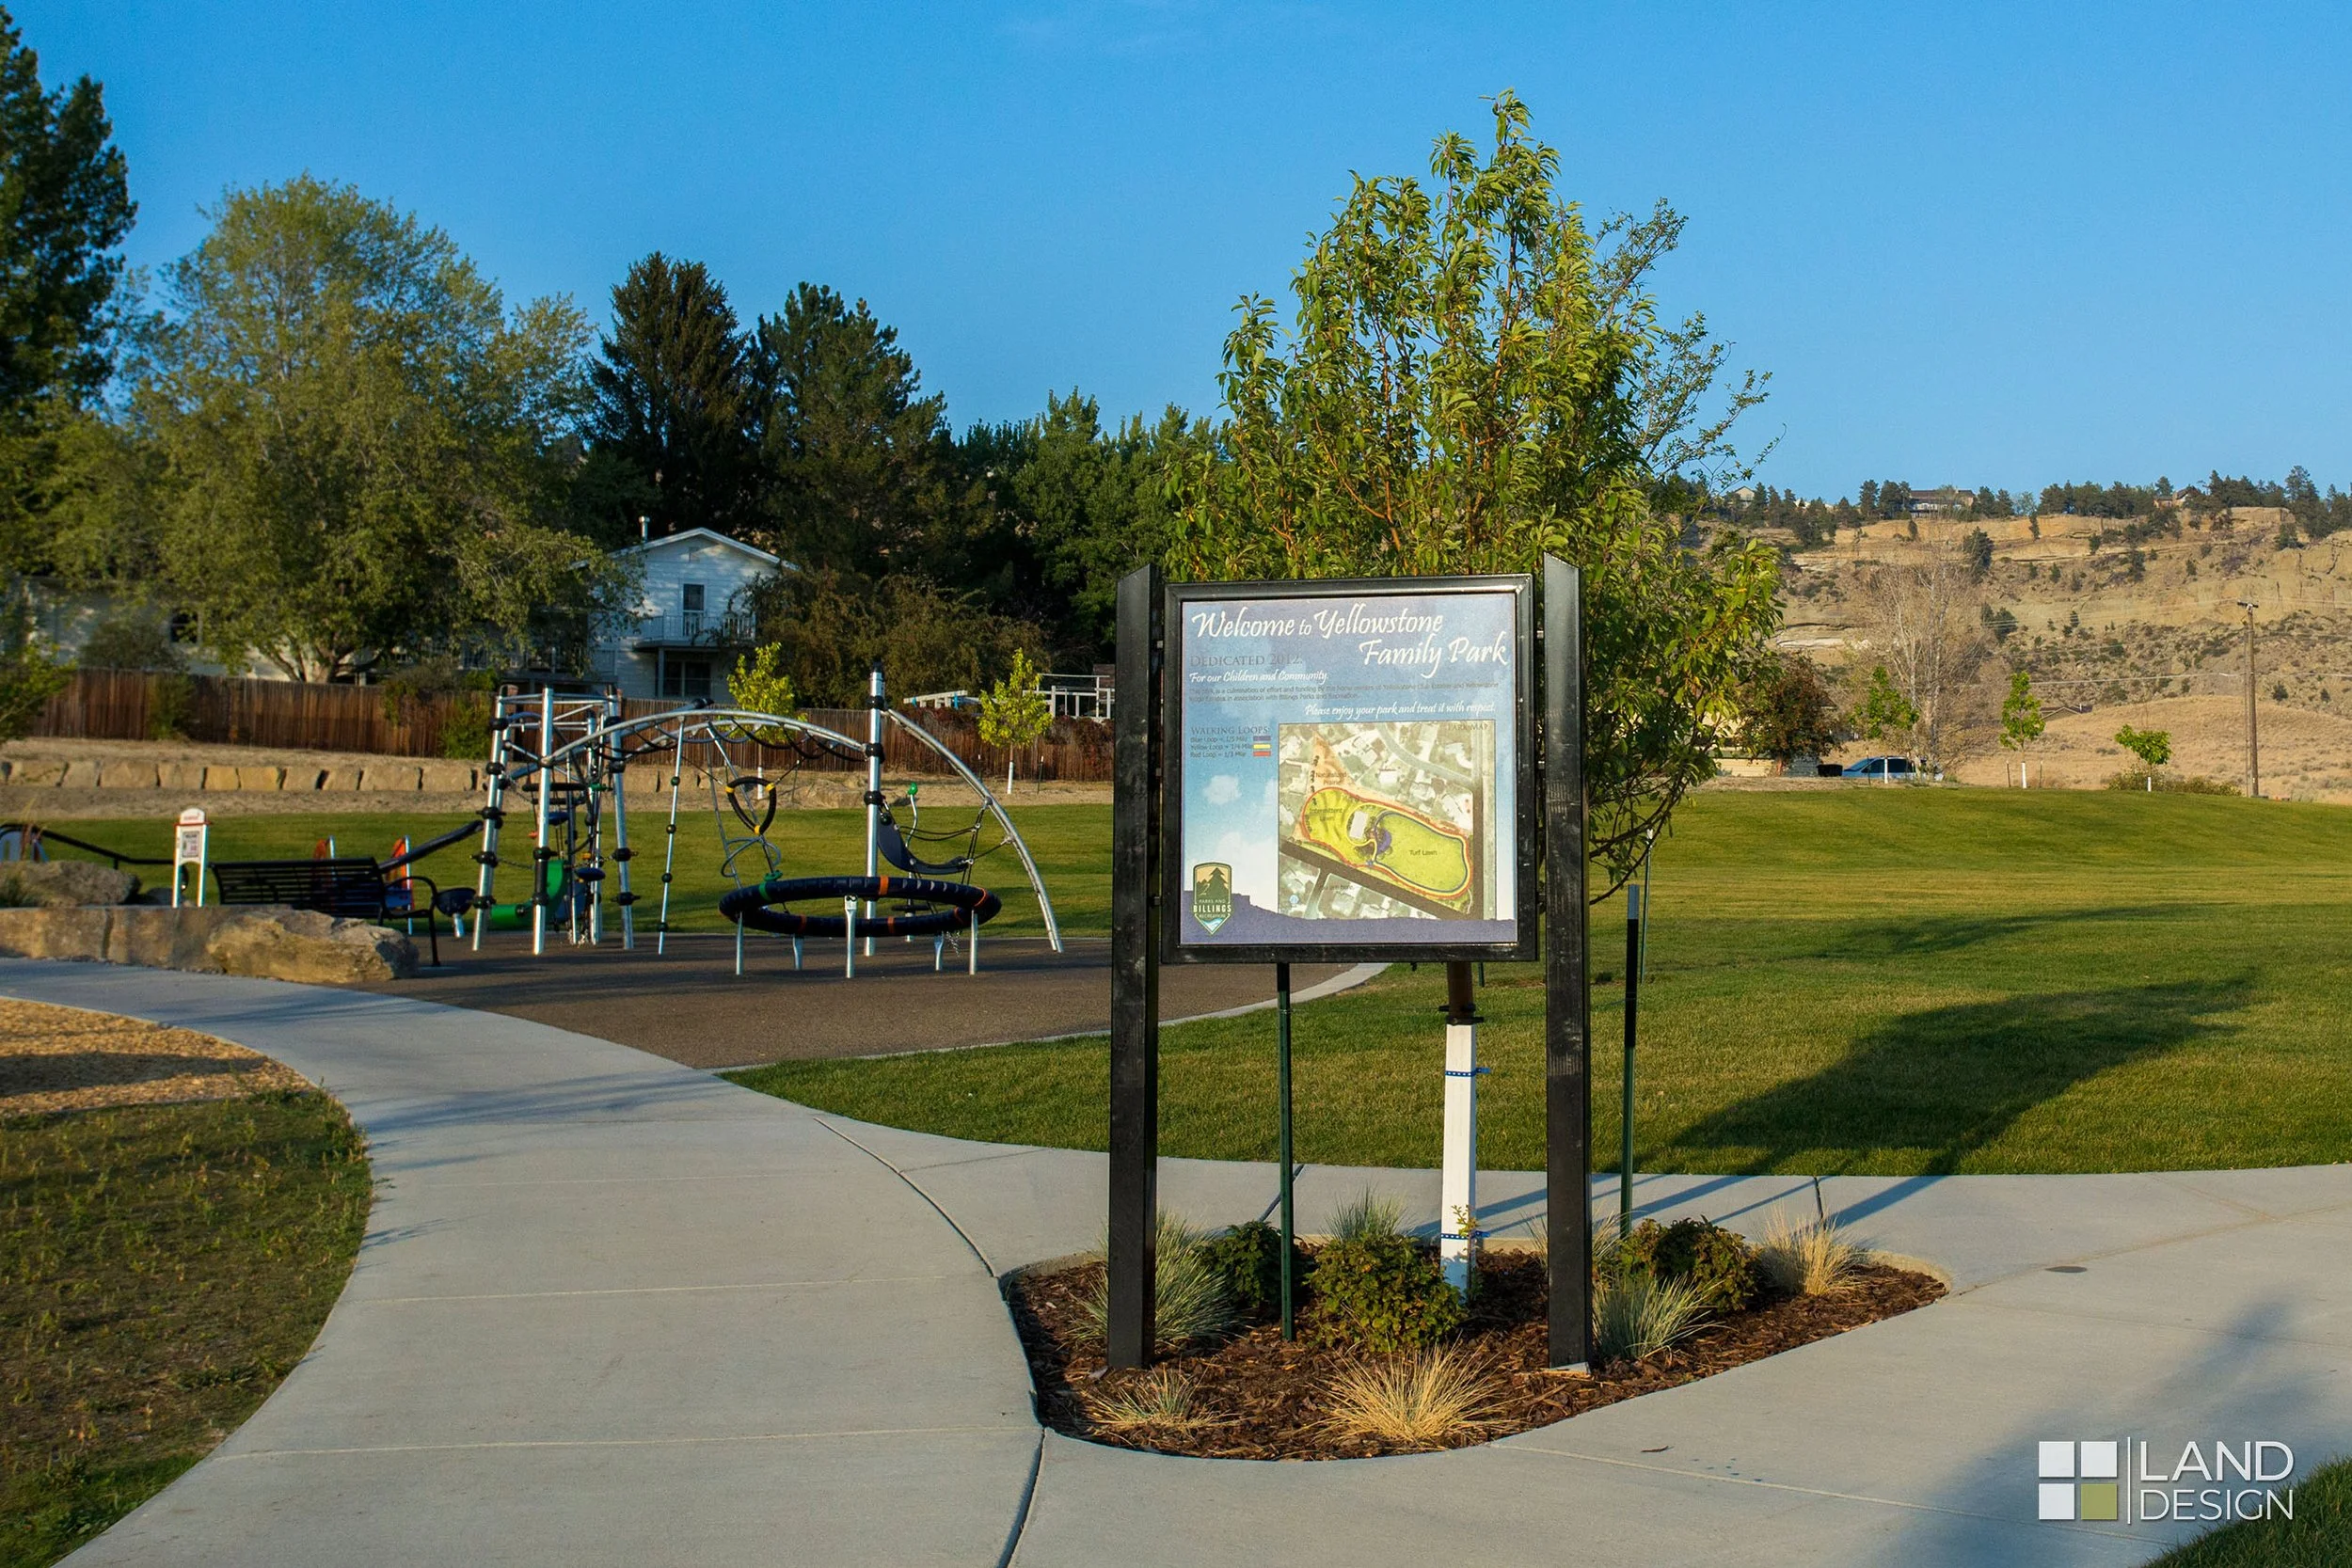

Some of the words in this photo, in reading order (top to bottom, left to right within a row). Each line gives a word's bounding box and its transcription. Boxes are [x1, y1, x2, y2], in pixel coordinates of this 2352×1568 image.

[1191, 606, 1295, 639] Welcome
[1298, 618, 1312, 636] to
[1313, 603, 1444, 640] Yellowstone
[1189, 654, 1265, 667] DEDICATED
[1359, 632, 1442, 678] Family
[1448, 630, 1509, 666] Park
[1189, 672, 1206, 683] For
[1207, 674, 1222, 683] our
[1223, 669, 1259, 683] Children
[1261, 668, 1279, 682] and
[1304, 703, 1330, 716] Please
[1331, 705, 1354, 720] enjoy
[1354, 706, 1376, 721] your
[1375, 701, 1398, 719] park
[1398, 700, 1418, 713] and
[1417, 703, 1438, 713] treat
[1438, 702, 1446, 712] it
[1446, 700, 1465, 712] with
[1190, 725, 1235, 735] WALKING
[1408, 848, 1422, 857] Turf
[1422, 848, 1438, 857] Lawn
[1193, 904, 1232, 913] BILLINGS
